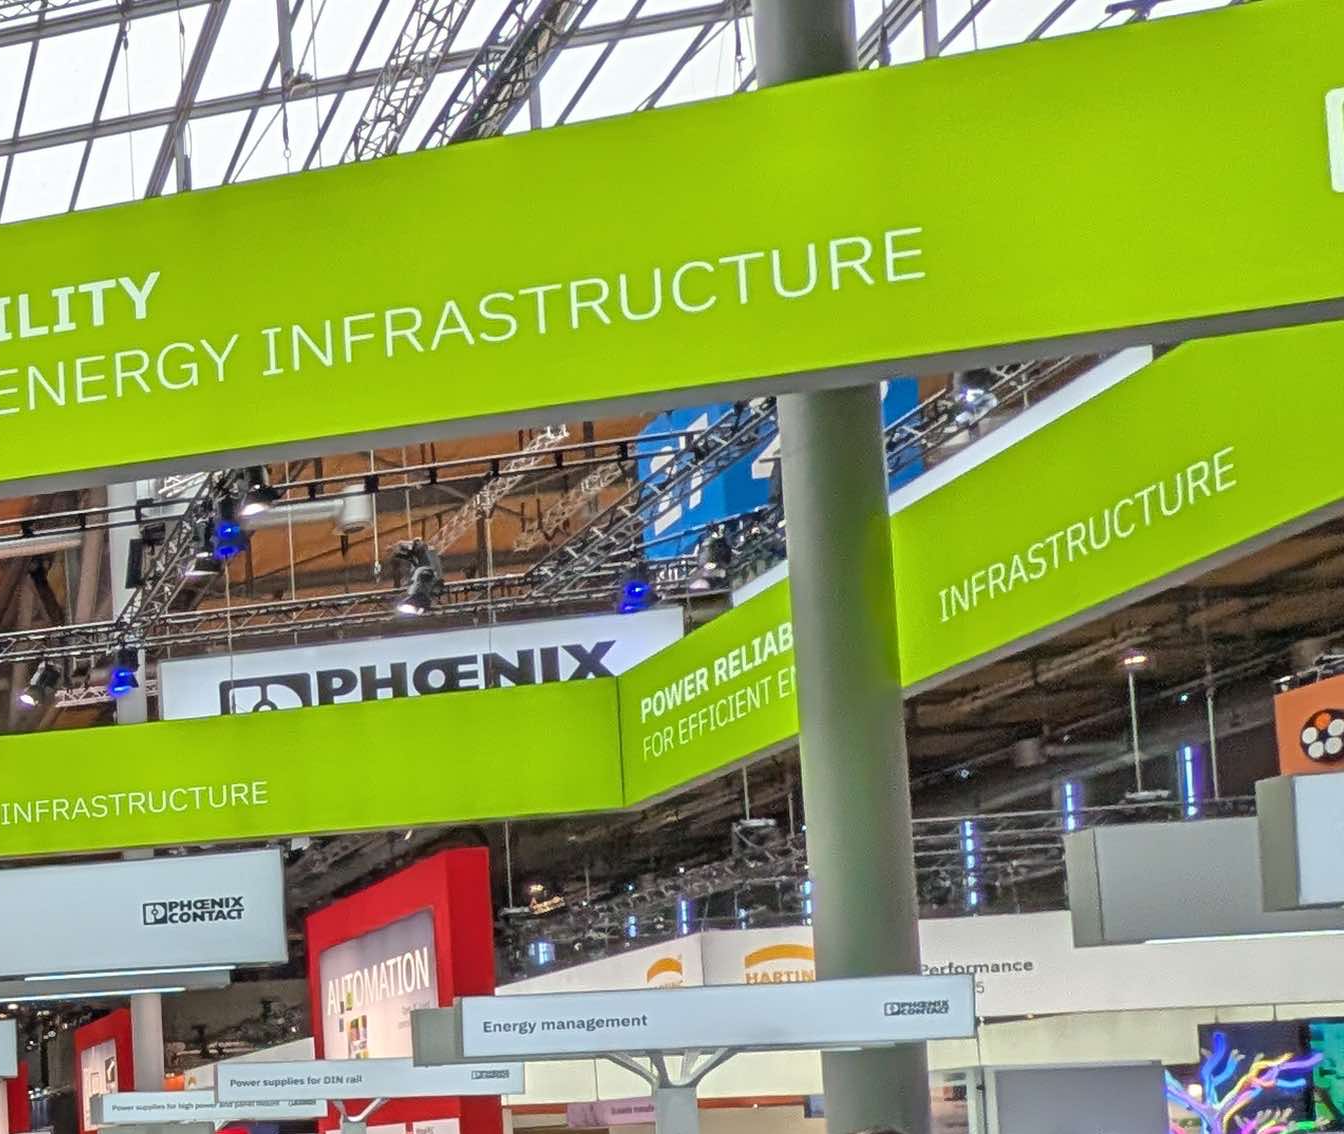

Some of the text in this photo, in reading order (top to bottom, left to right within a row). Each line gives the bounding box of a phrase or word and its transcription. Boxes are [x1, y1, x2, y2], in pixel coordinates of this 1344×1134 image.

[261, 226, 927, 377] INFRASTRUCTURE
[937, 446, 1237, 624] INFRASTRUCTURE
[640, 667, 709, 723] POWER
[642, 727, 674, 763] FOR
[678, 676, 773, 746] EFFICIENT
[0, 780, 269, 826] INFRASTRUCTURE
[167, 908, 245, 924] CONTACT
[326, 946, 431, 1017] AUTOMATION
[921, 961, 1034, 976] Performance
[482, 1013, 649, 1035] Energy management
[230, 1075, 363, 1088] Power supplies for DIN rail
